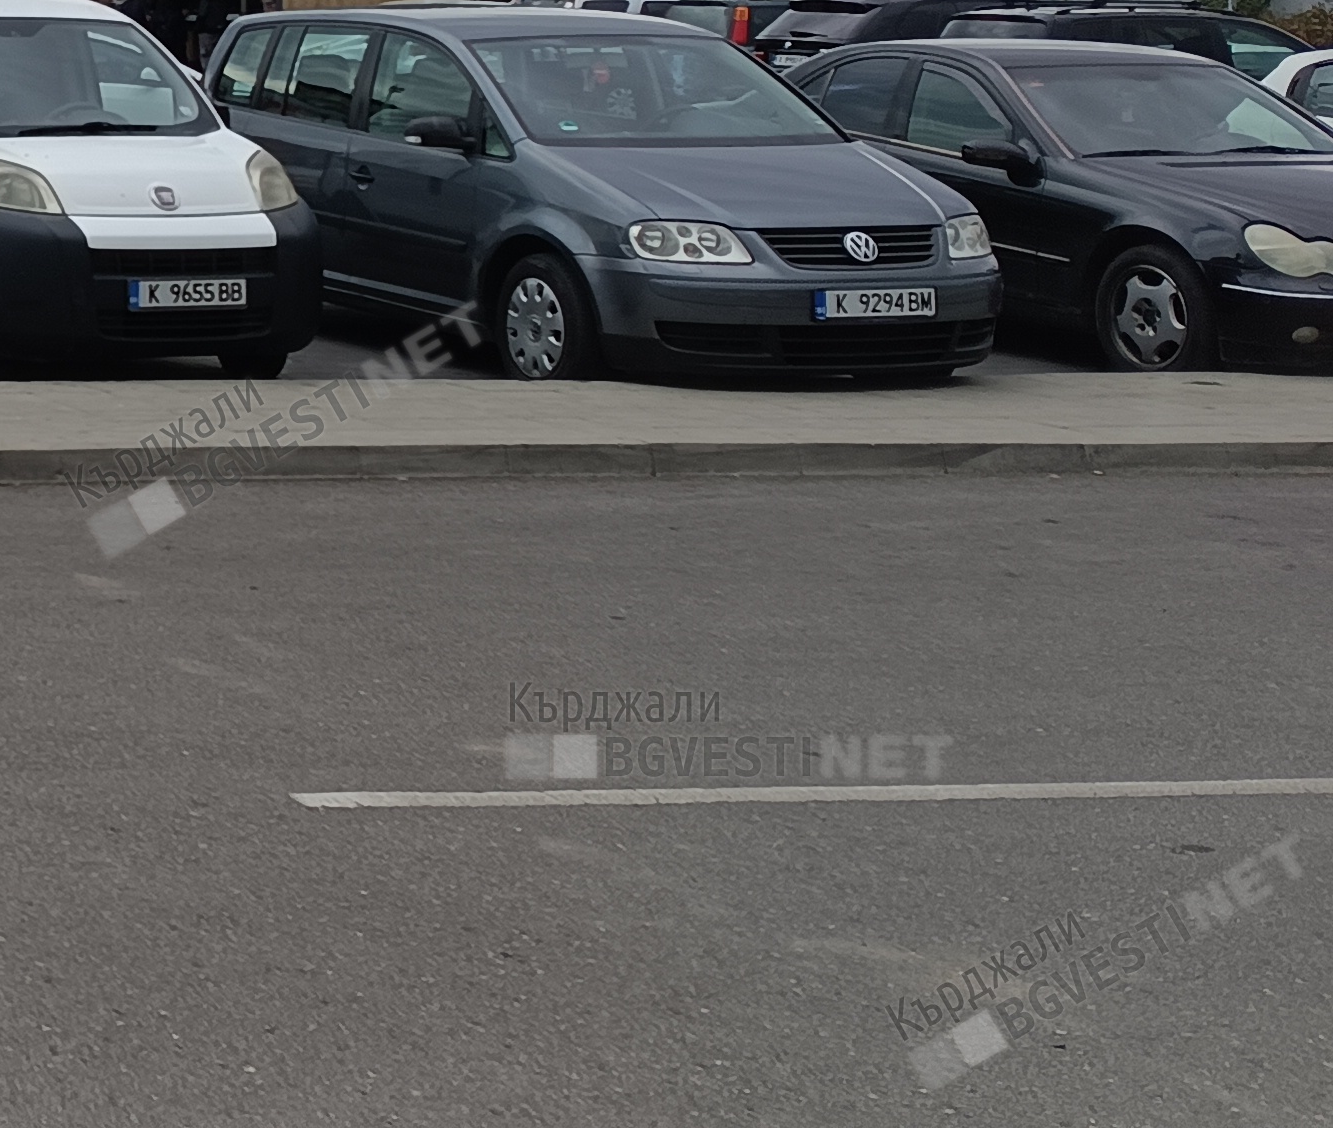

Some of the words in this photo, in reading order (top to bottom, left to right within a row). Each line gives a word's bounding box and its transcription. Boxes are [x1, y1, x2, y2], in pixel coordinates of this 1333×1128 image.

[148, 284, 161, 304] K
[169, 282, 216, 304] 9655
[218, 281, 243, 303] BB
[836, 293, 849, 314] K
[858, 292, 905, 314] 9294
[908, 290, 933, 312] BM
